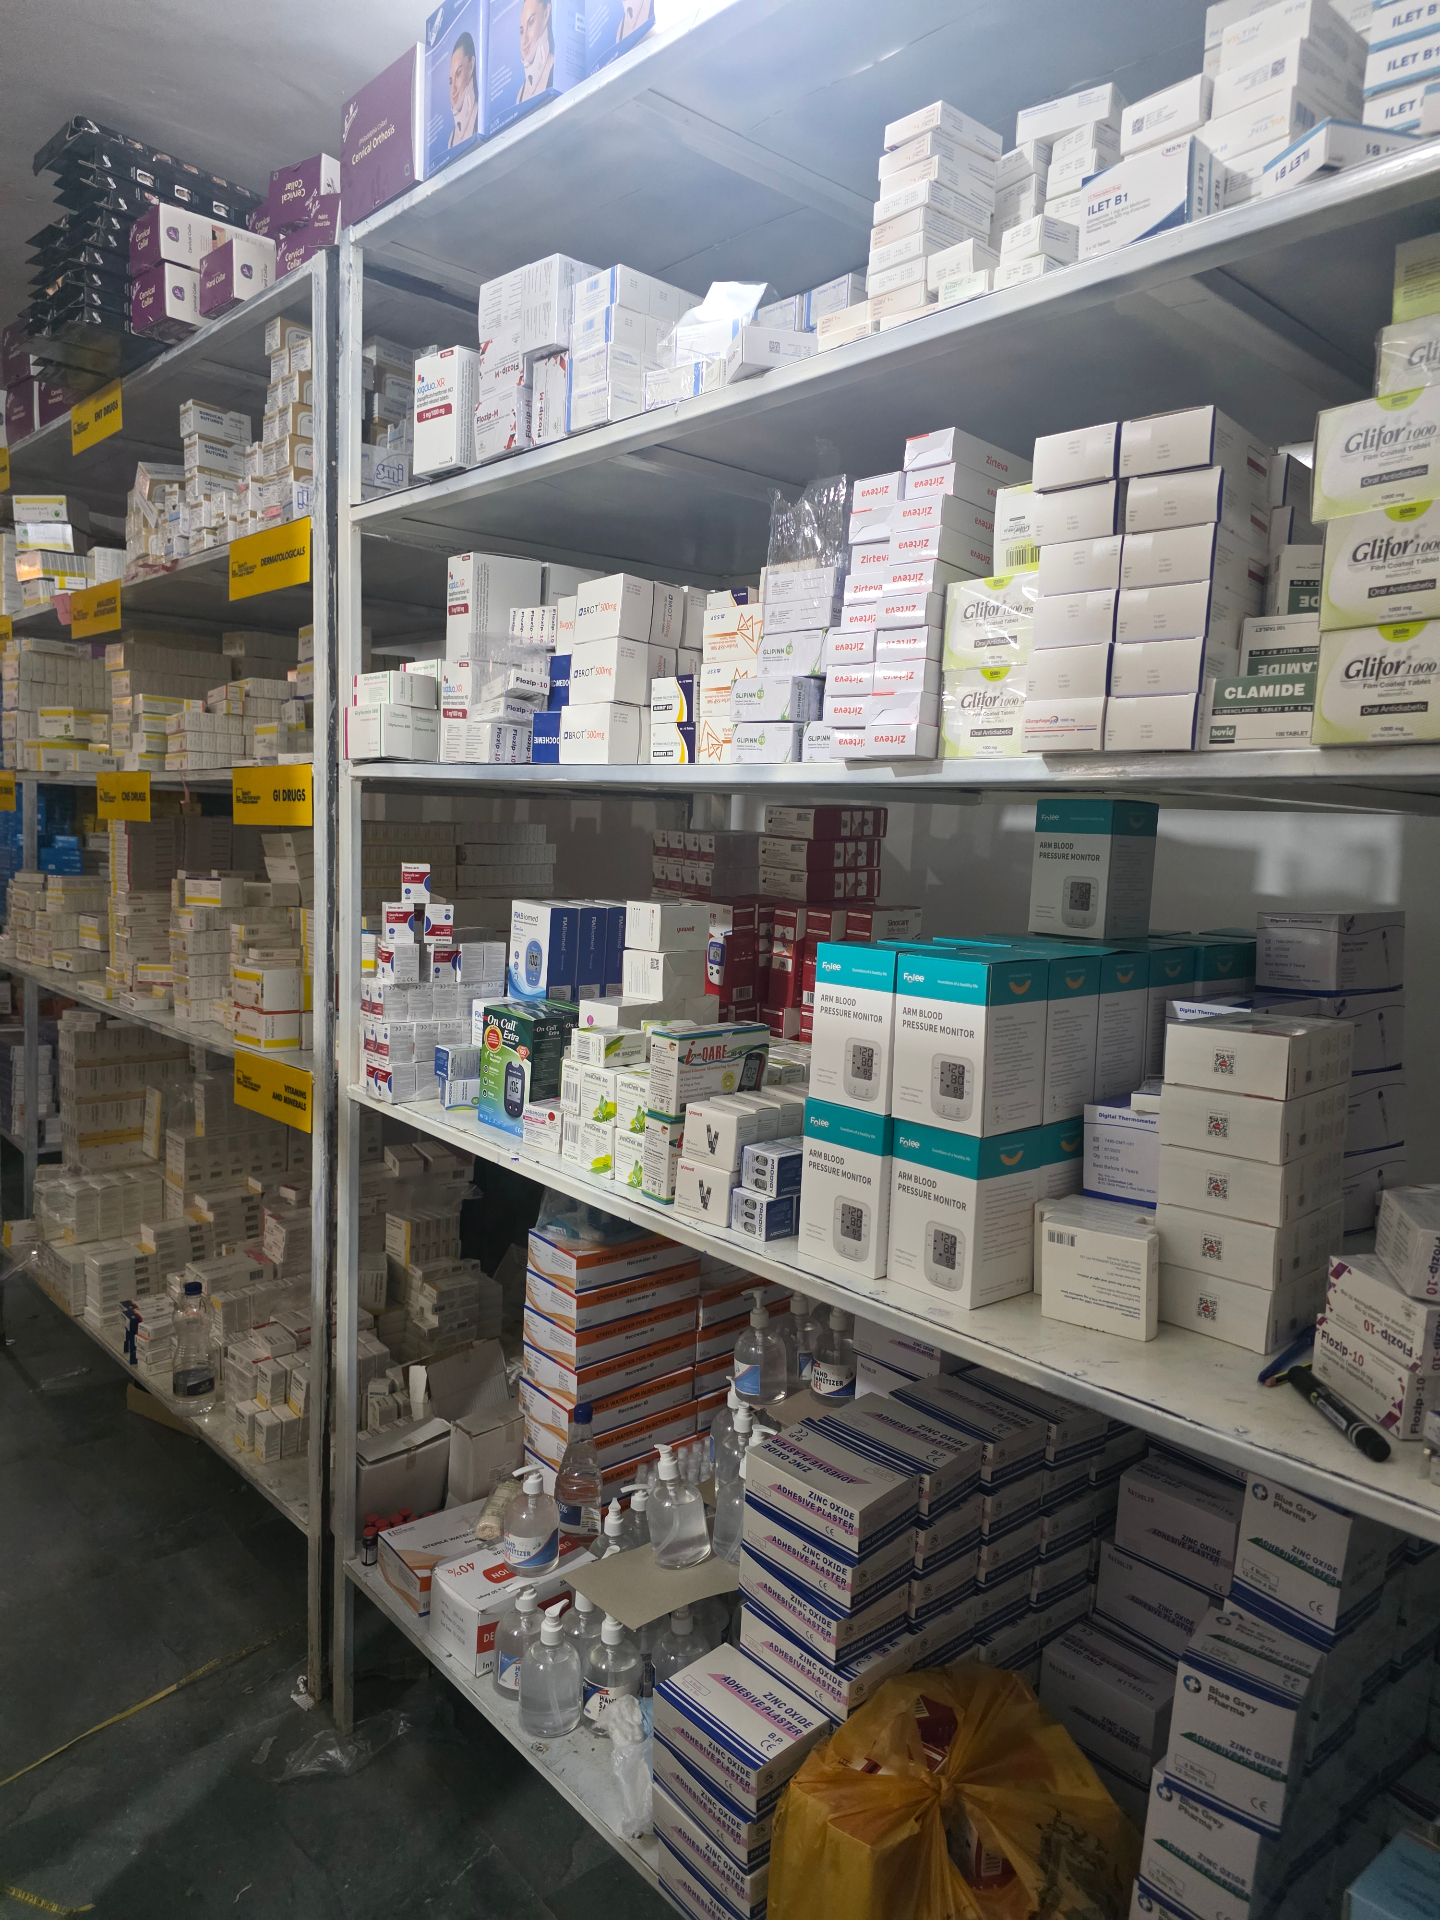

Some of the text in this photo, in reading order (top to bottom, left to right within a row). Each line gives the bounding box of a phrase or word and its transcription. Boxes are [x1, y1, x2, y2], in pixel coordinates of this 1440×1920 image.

[1387, 53, 1419, 71] ILET
[1385, 100, 1416, 119] ILET
[352, 124, 395, 165] Cervical Orthosis
[282, 189, 305, 204] Cervical
[1088, 193, 1128, 216] ILET B1
[137, 237, 149, 250] Collar
[142, 296, 154, 308] Collar
[495, 362, 519, 378] Flozip-M
[94, 400, 118, 423] ENT DRUGS
[199, 410, 224, 421] SURGICAL
[477, 409, 498, 424] Flozip-M
[199, 416, 224, 426] SUTURES
[1344, 425, 1437, 454] Glifor 1000
[204, 444, 228, 455] SURGICAL
[205, 449, 228, 459] SUTURES
[1406, 442, 1431, 454] Tablet
[915, 476, 945, 488] Zirteva
[1363, 466, 1427, 486] Oral Antidiabetic
[862, 485, 889, 497] Zirteva
[903, 506, 932, 518] Zirteva
[898, 538, 930, 550] Zirteva
[1352, 536, 1414, 565] Glifor
[261, 546, 305, 567] DERMATOLOGICALS
[1387, 560, 1412, 570] Coated
[1370, 581, 1435, 597] Oral Antidiabetic
[600, 603, 617, 612] 500mg
[835, 642, 864, 652] Zirteva
[595, 667, 612, 675] 500mg
[1344, 656, 1437, 680] Glifor 1000
[516, 676, 548, 689] Flozip-10
[1379, 680, 1405, 688] Coated
[1406, 678, 1431, 686] Tablet
[1224, 684, 1305, 699] CLAMIDE
[1380, 702, 1427, 713] Antidiabetic
[587, 730, 605, 740] 500mg
[1212, 728, 1234, 736] hovid
[122, 792, 130, 801] CNS
[131, 792, 146, 802] DRUGS
[273, 790, 280, 802] GI
[282, 789, 306, 802] DRUGS
[822, 961, 841, 972] Folee
[904, 972, 924, 983] Folee
[820, 994, 856, 1006] ARM BLOOD
[820, 1006, 883, 1023] PRESSURE MONITOR
[903, 1007, 942, 1020] ARM BLOOD
[488, 1014, 516, 1031] On Call
[902, 1019, 974, 1039] PRESSURE MONITOR
[504, 1031, 519, 1042] Extra
[284, 1085, 306, 1099] VITAMINS
[272, 1092, 306, 1111] AND MINERALS
[810, 1116, 829, 1129] Folee
[1099, 1112, 1156, 1125] Digital Thermometer
[809, 1149, 845, 1165] ARM BLOOD
[808, 1161, 872, 1186] PRESSURE MONITOR
[1104, 1164, 1119, 1172] Before
[898, 1170, 937, 1189] ARM BLOOD
[898, 1183, 967, 1212] PRESSURE MONITOR
[597, 1278, 673, 1301] STERILE WATER FOR INJECTION
[626, 1292, 656, 1304] Recowater-10
[617, 1323, 635, 1334] WATER
[647, 1311, 671, 1324] INJECTION
[625, 1328, 654, 1340] Recowater-10
[1363, 1319, 1413, 1358] Flozip-10
[1321, 1330, 1364, 1367] Flozip-10
[813, 1369, 828, 1379] HAND
[813, 1376, 844, 1387] SANITIZER
[1411, 1378, 1425, 1434] Flozip-10
[777, 1484, 854, 1531] ADHESIVE PLASTER
[808, 1491, 855, 1521] ZINC OXIDE
[1273, 1501, 1306, 1523] Pharma
[1275, 1492, 1317, 1520] Blue Grey
[422, 1538, 448, 1549] STERILE
[772, 1535, 809, 1565] ADHESIVE
[802, 1544, 847, 1576] ZINC OXIDE
[448, 1562, 475, 1577] 40%
[763, 1583, 832, 1639] ADHESIVE PLASTER
[790, 1594, 832, 1629] ZINC OXIDE
[769, 1642, 842, 1699] ADHESIVE PLASTER
[798, 1653, 843, 1688] ZINC OXIDE
[1207, 1694, 1245, 1718] Pharma
[1209, 1685, 1258, 1714] Blue Grey
[763, 1692, 814, 1728] ZINC OXIDE
[768, 1732, 784, 1745] B.P.
[680, 1728, 751, 1788] ADHESIVE PLASTER
[727, 1757, 751, 1779] OXIDE
[676, 1774, 742, 1840] ADHESIVE PLASTER
[1180, 1795, 1224, 1829] Blue Grey
[1178, 1804, 1213, 1832] Pharma
